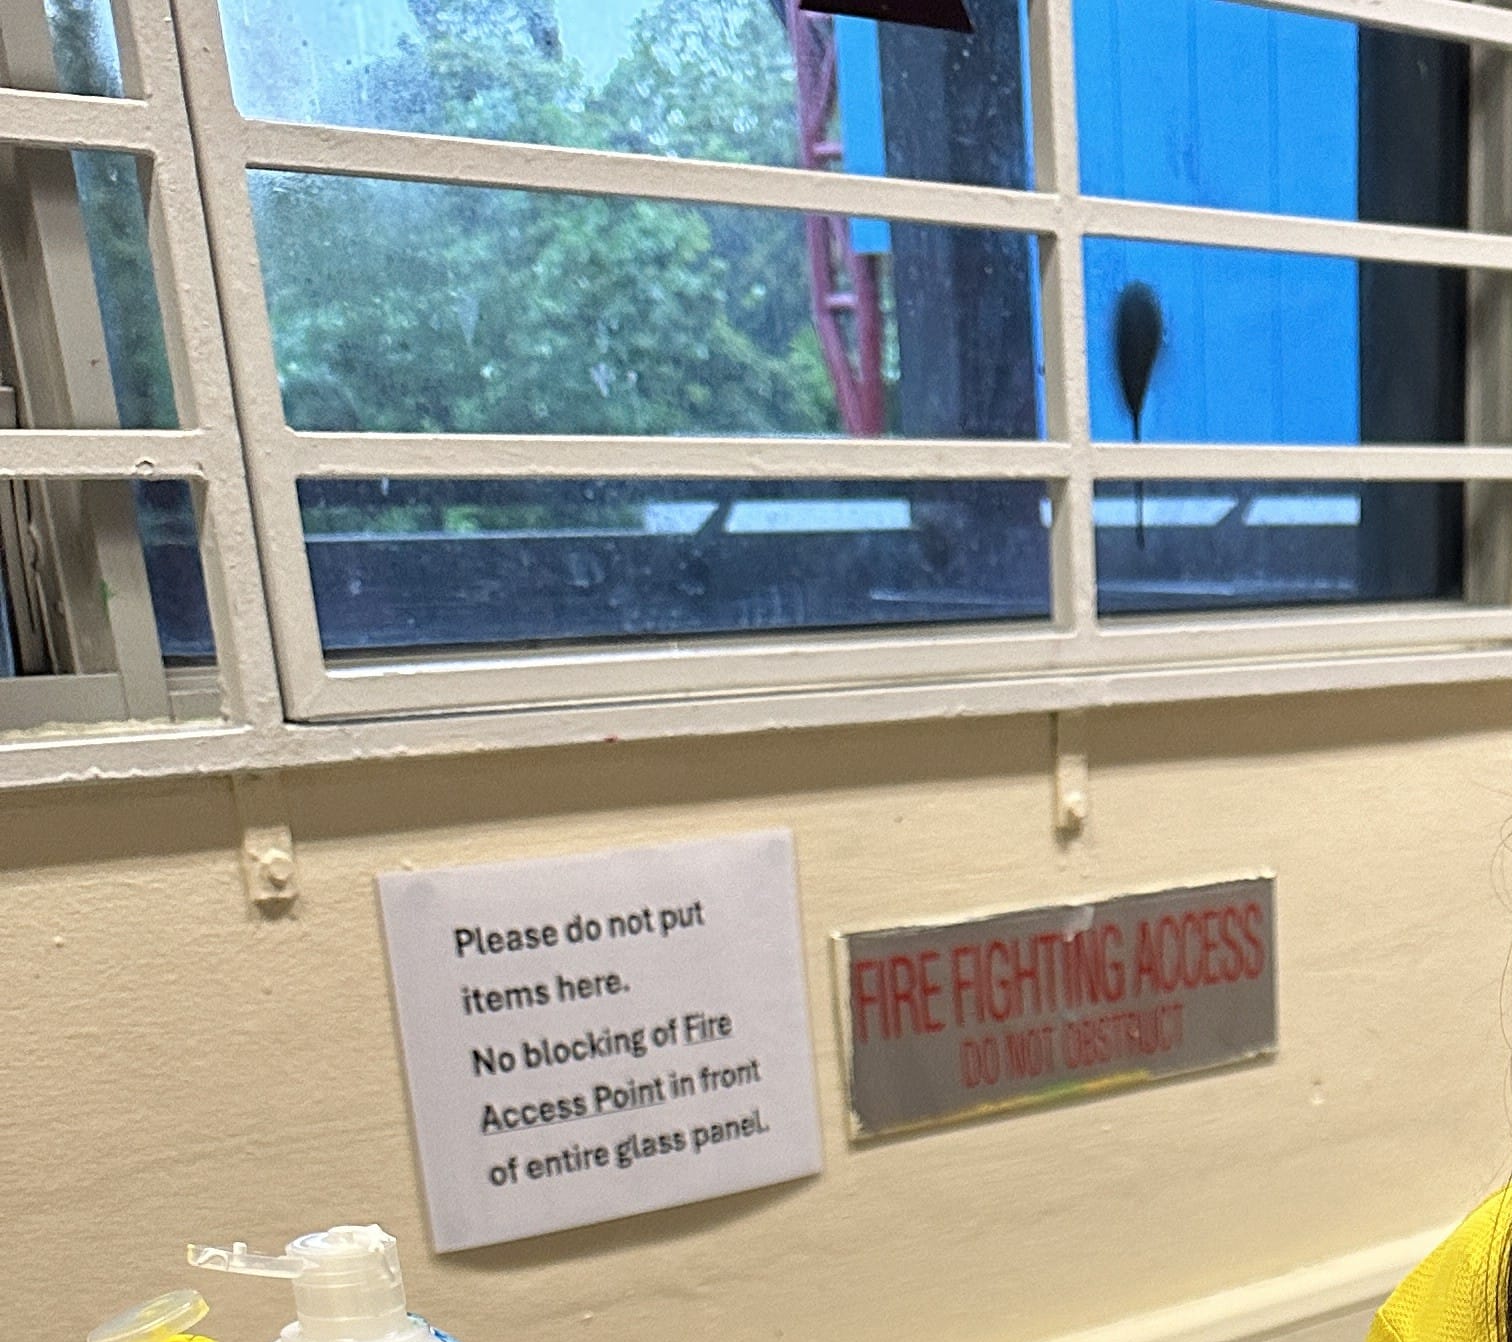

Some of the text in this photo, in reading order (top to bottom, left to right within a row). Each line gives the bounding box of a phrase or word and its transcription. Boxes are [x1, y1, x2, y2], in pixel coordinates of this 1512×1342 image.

[454, 900, 705, 958] Please do not put
[462, 970, 630, 1015] items here.
[853, 902, 1266, 1044] FIRE FIGHTING ACCESS
[472, 1012, 733, 1077] No blocking of Fire
[959, 1003, 1184, 1088] DO NOT OBSTRUCT
[482, 1058, 762, 1132] Access Point in front
[489, 1109, 770, 1186] of entire glass panel.
